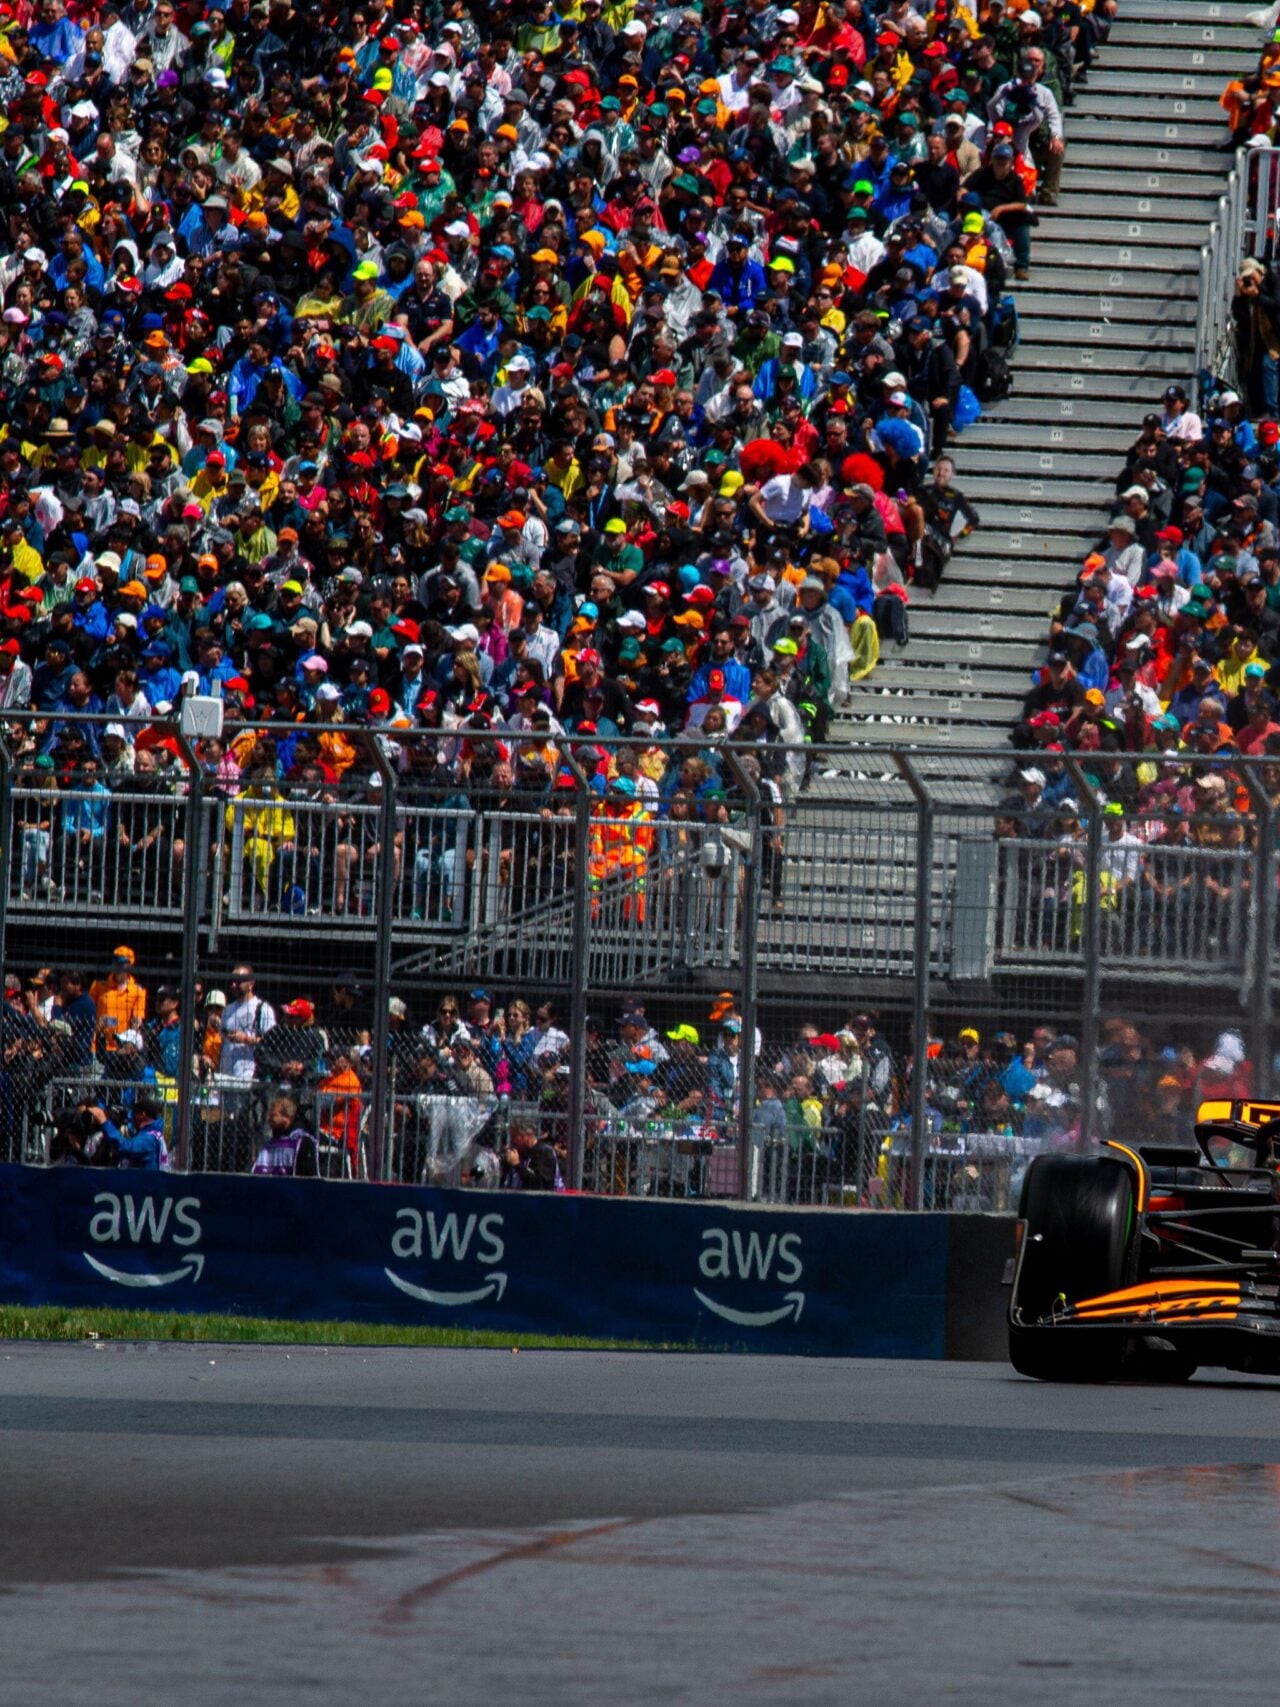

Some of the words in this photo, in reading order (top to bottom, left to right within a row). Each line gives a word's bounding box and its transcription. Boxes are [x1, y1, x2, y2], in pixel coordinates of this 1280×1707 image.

[90, 1193, 201, 1245] aws
[392, 1208, 504, 1263] aws
[699, 1229, 802, 1283] aws
